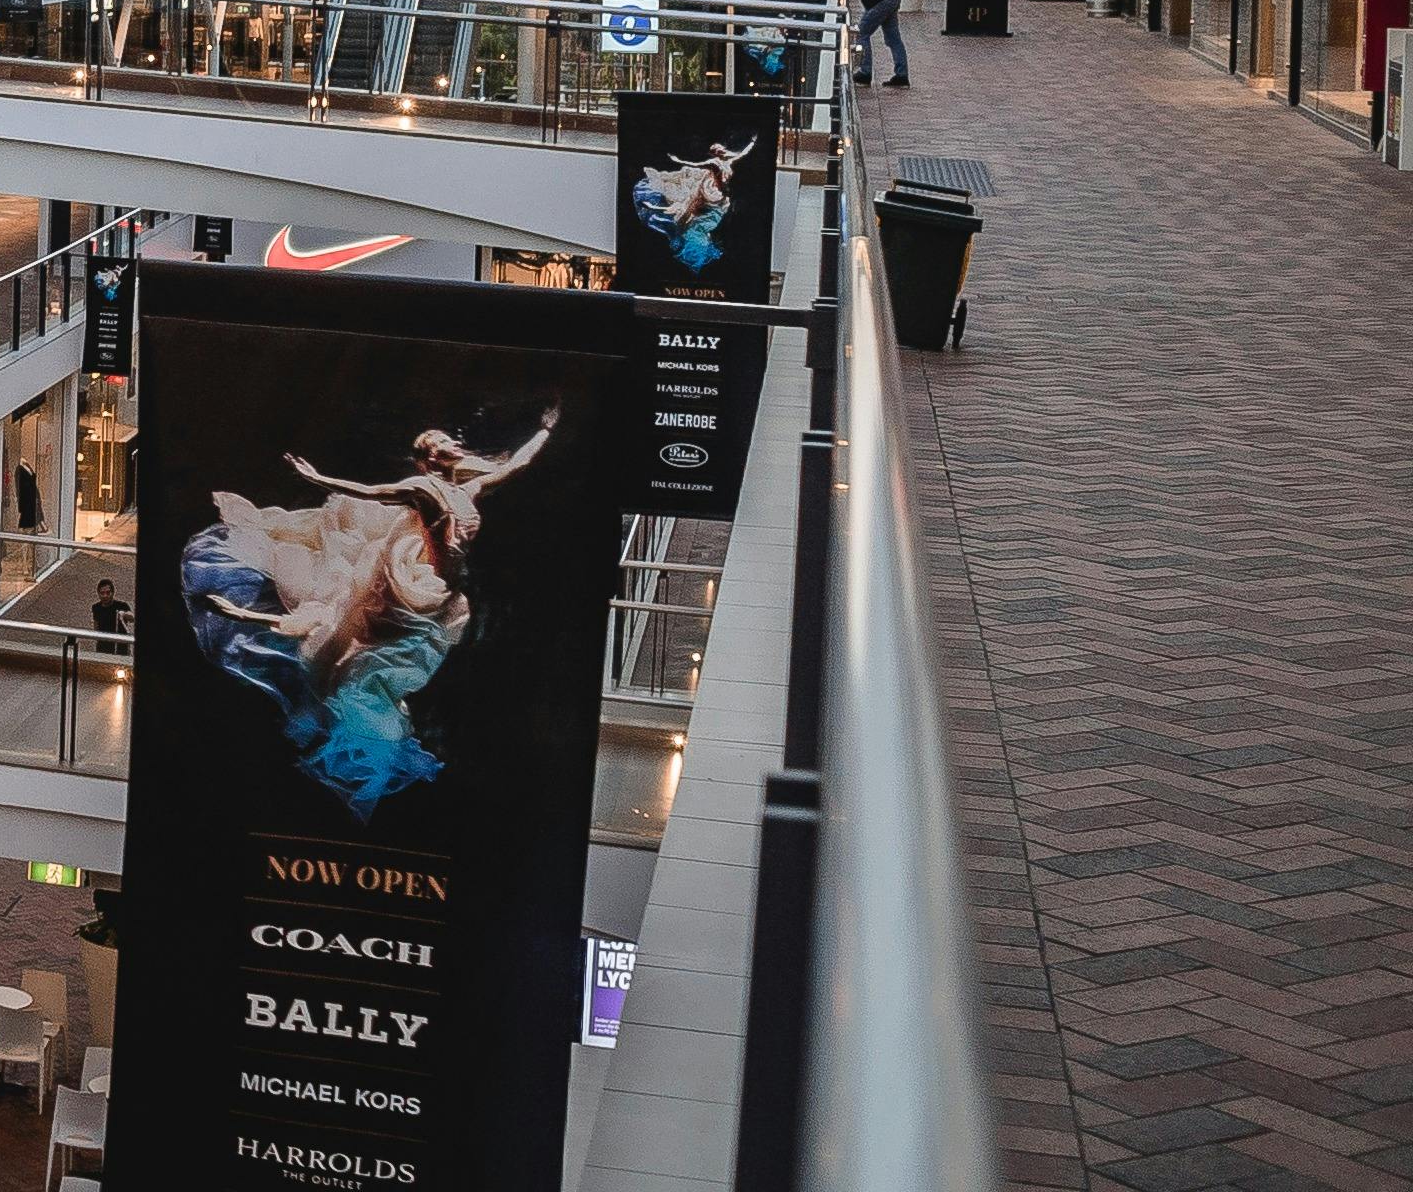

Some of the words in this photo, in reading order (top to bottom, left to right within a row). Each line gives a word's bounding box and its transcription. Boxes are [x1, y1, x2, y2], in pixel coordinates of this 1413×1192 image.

[664, 287, 692, 297] NOW
[694, 288, 726, 298] OPEN
[658, 333, 721, 350] BALLY
[657, 361, 694, 371] MICHAEL
[696, 363, 720, 373] KORS
[656, 383, 719, 396] HARROLDS
[654, 412, 717, 429] ZANEROBE
[267, 856, 348, 887] NOW
[357, 866, 448, 902] OPEN
[251, 924, 434, 968] COACH
[245, 992, 429, 1048] BALLY
[240, 1071, 347, 1105] MICHAEL
[355, 1087, 422, 1116] KORS
[237, 1136, 416, 1184] HARROLDS
[282, 1168, 306, 1183] THE
[311, 1174, 363, 1191] OUTLET
